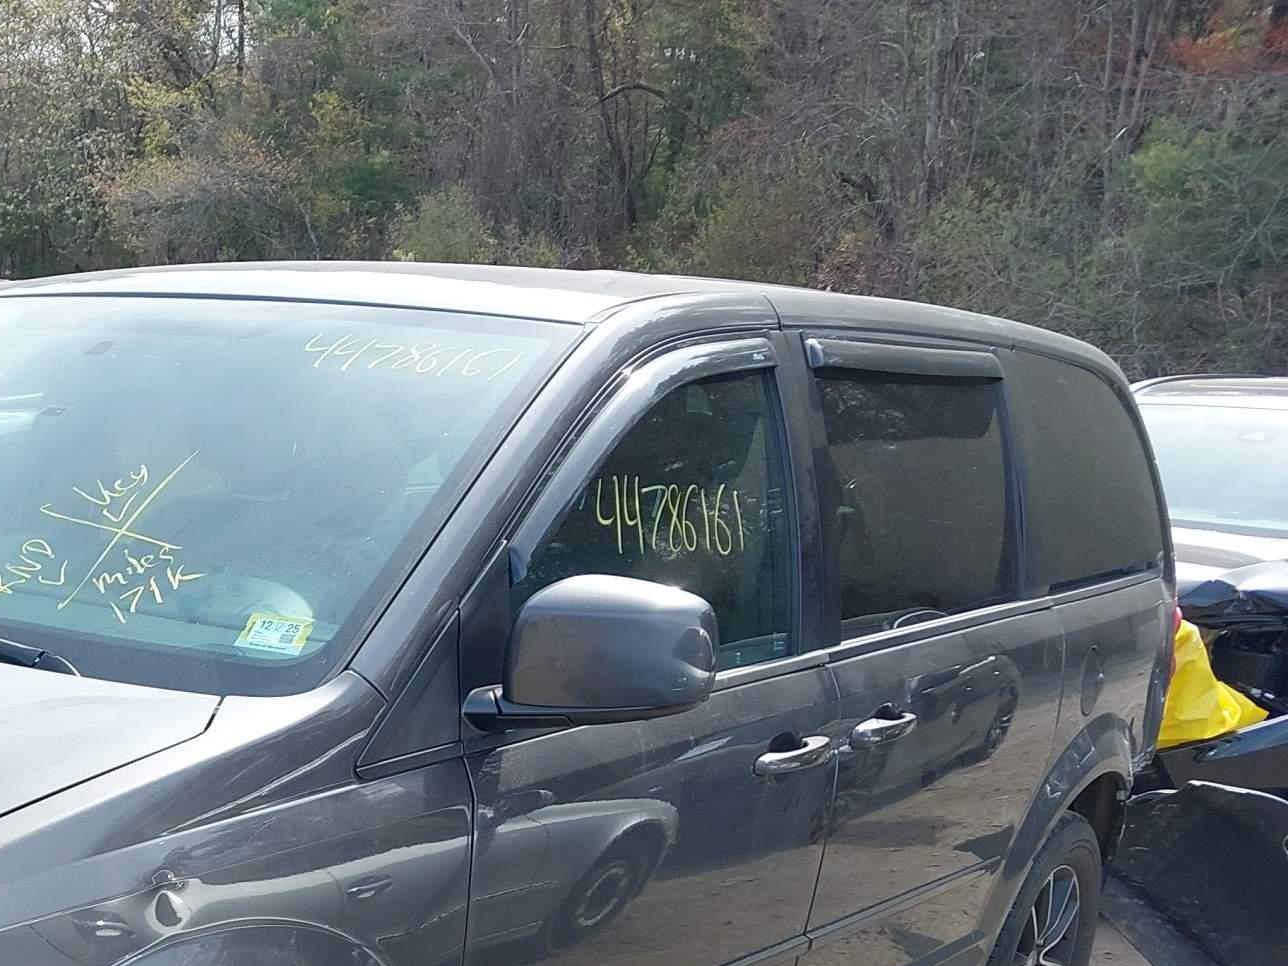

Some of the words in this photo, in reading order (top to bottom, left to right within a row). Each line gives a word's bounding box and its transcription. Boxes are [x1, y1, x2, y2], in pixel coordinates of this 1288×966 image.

[304, 332, 525, 381] 44786161
[596, 474, 746, 556] 44786161
[260, 620, 274, 631] 12
[285, 623, 302, 634] 25
